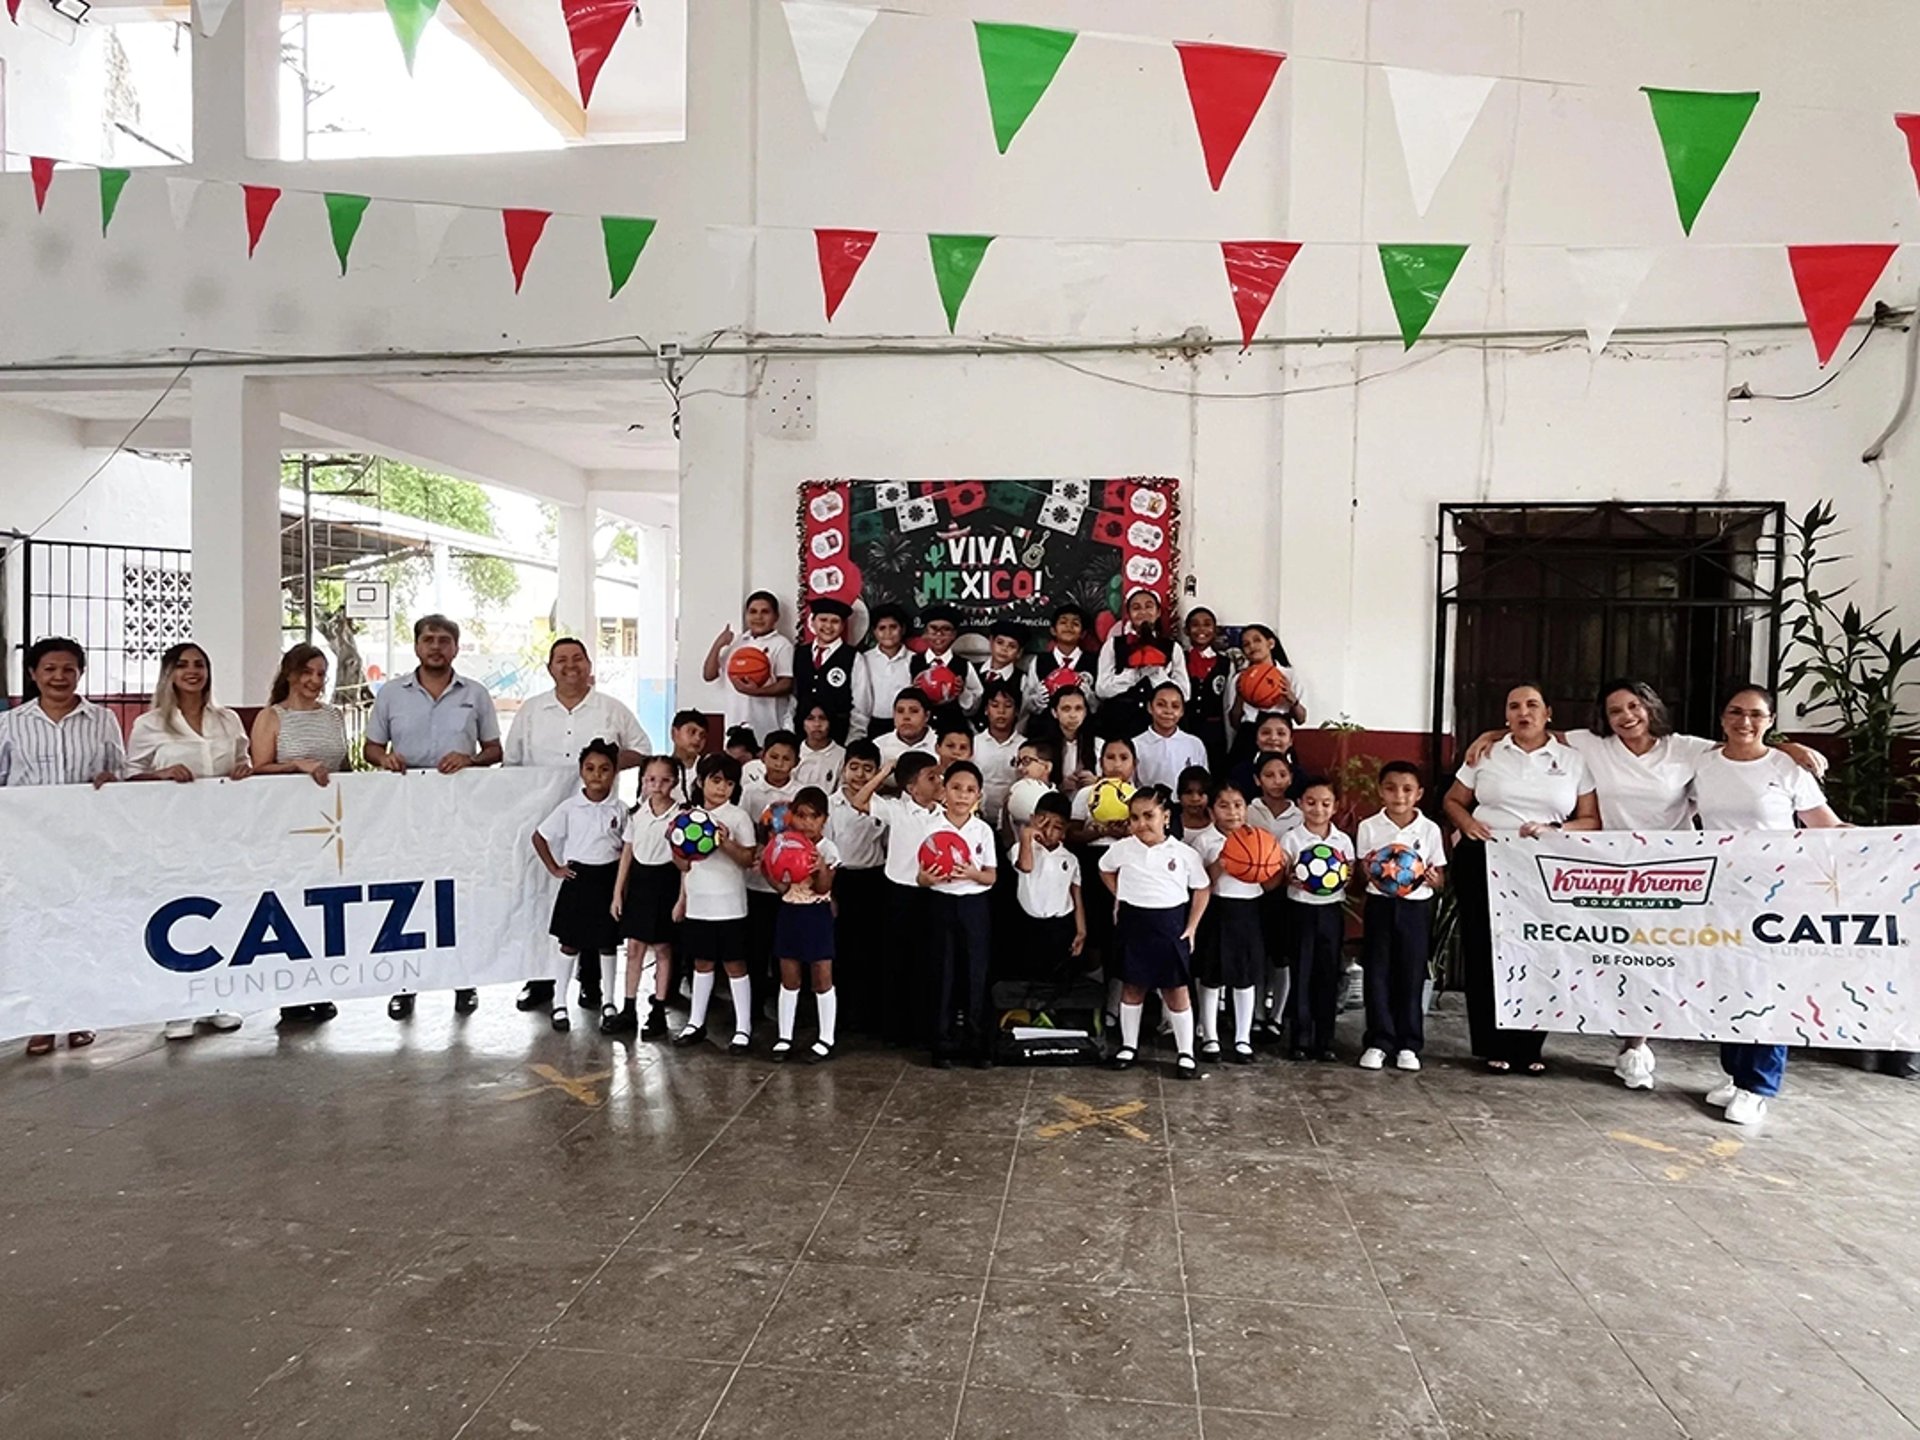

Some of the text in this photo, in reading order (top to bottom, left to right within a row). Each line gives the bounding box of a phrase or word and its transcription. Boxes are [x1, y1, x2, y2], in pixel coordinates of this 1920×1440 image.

[948, 536, 1018, 565] VIVA
[1552, 868, 1706, 896] Krispy Kreme
[1579, 898, 1675, 908] DOUGHNUTS
[144, 879, 456, 973] CATZI
[1523, 922, 1742, 946] RECAUDACCIÓN
[1752, 913, 1899, 946] CATZI
[1592, 954, 1676, 968] DE FONDOS
[187, 956, 423, 999] FUNDACIÓN
